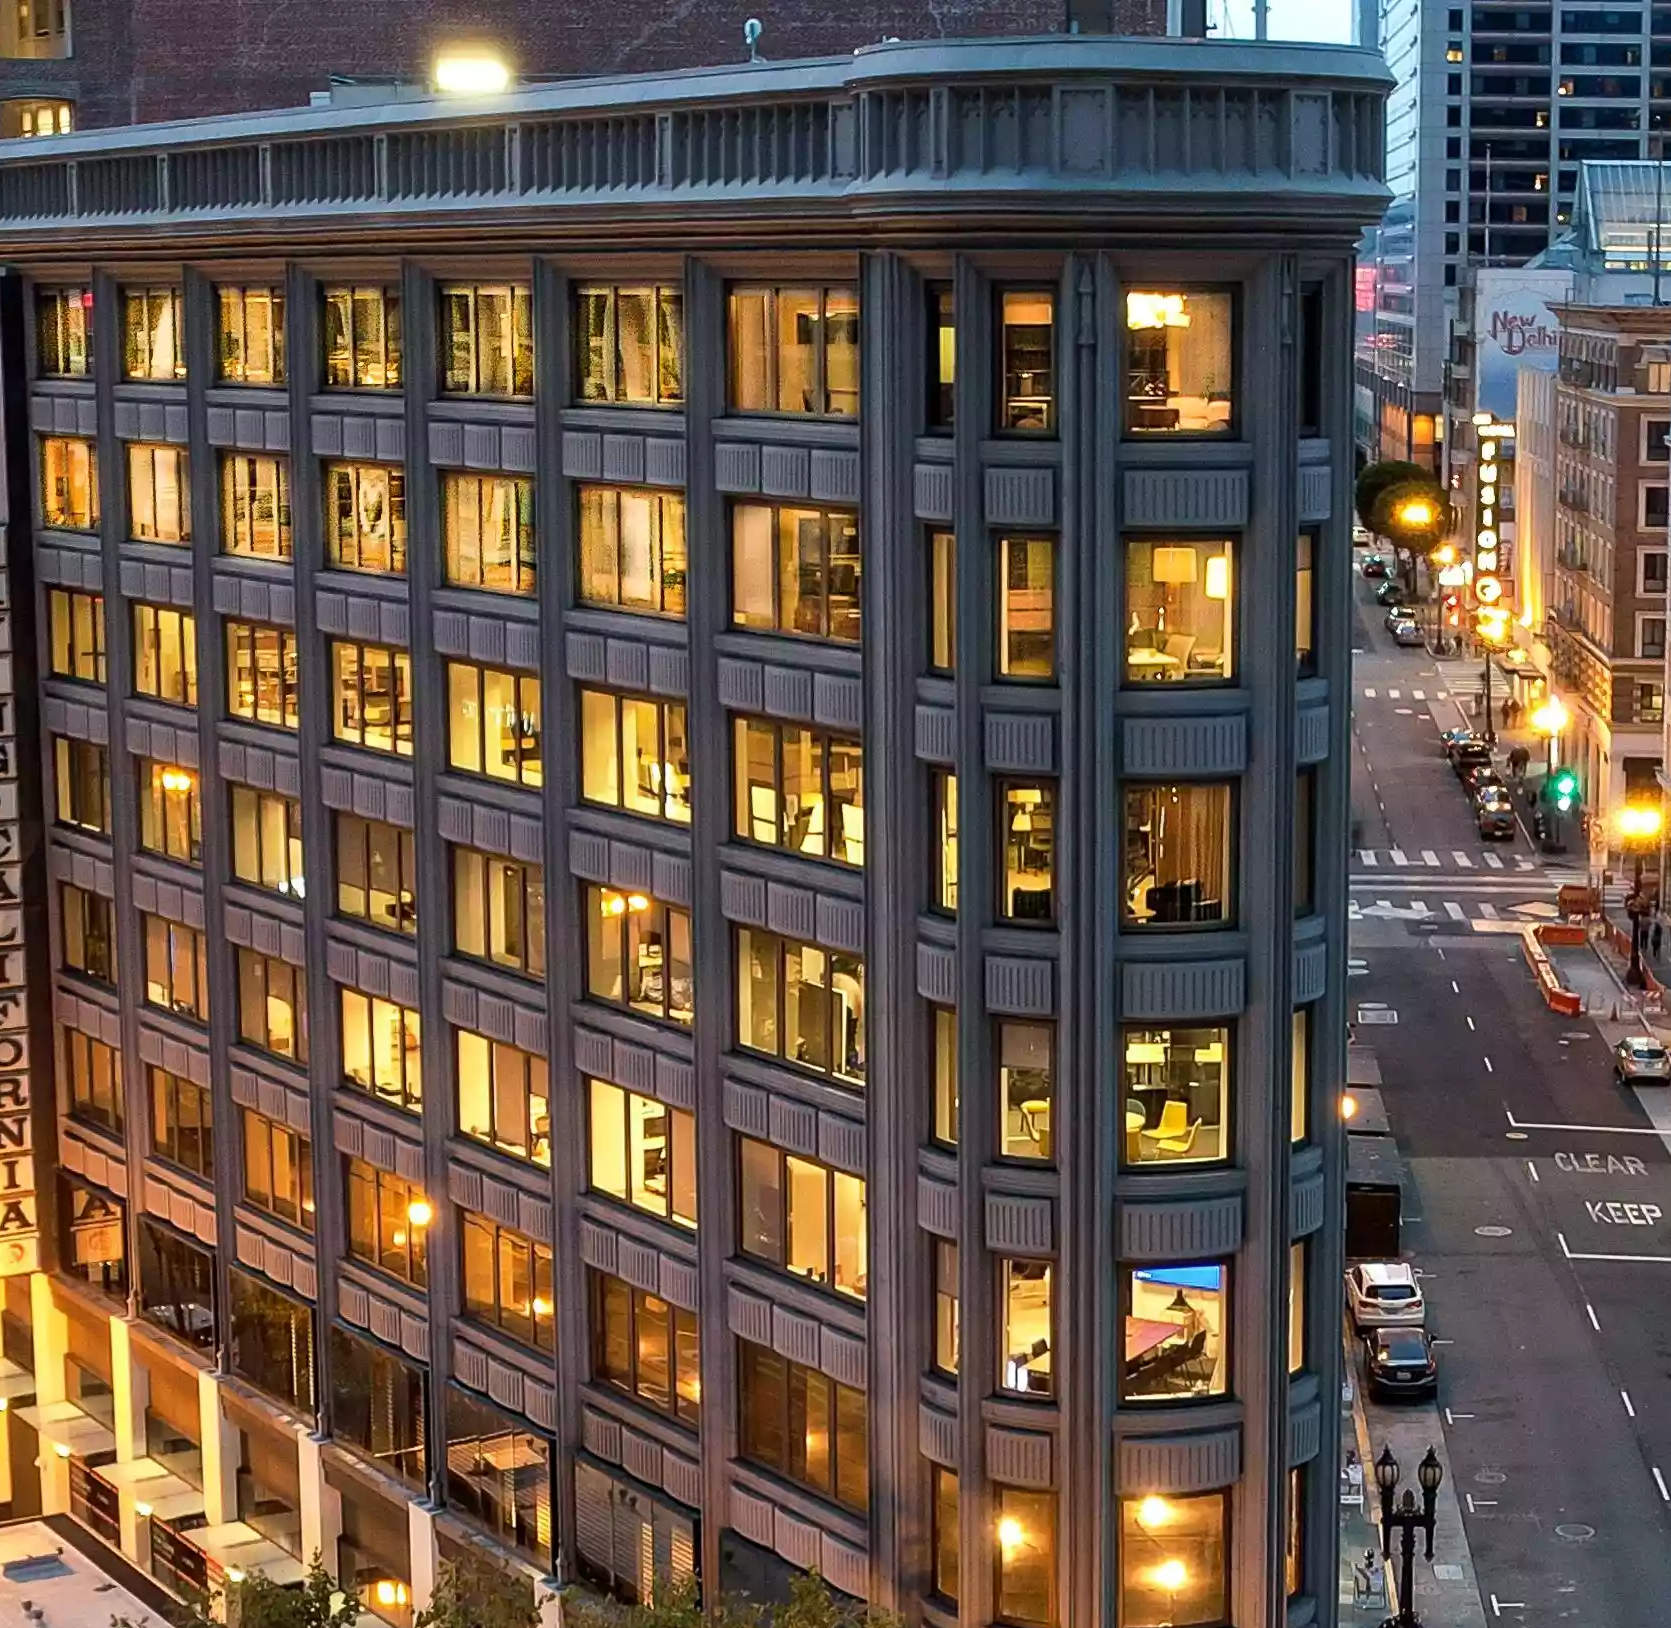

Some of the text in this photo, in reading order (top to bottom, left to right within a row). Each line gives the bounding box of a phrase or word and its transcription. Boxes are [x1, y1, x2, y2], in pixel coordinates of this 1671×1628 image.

[1489, 309, 1537, 341] New
[1499, 325, 1559, 355] Delhi
[1554, 1152, 1649, 1177] CLEAR
[1585, 1201, 1663, 1227] KEEP
